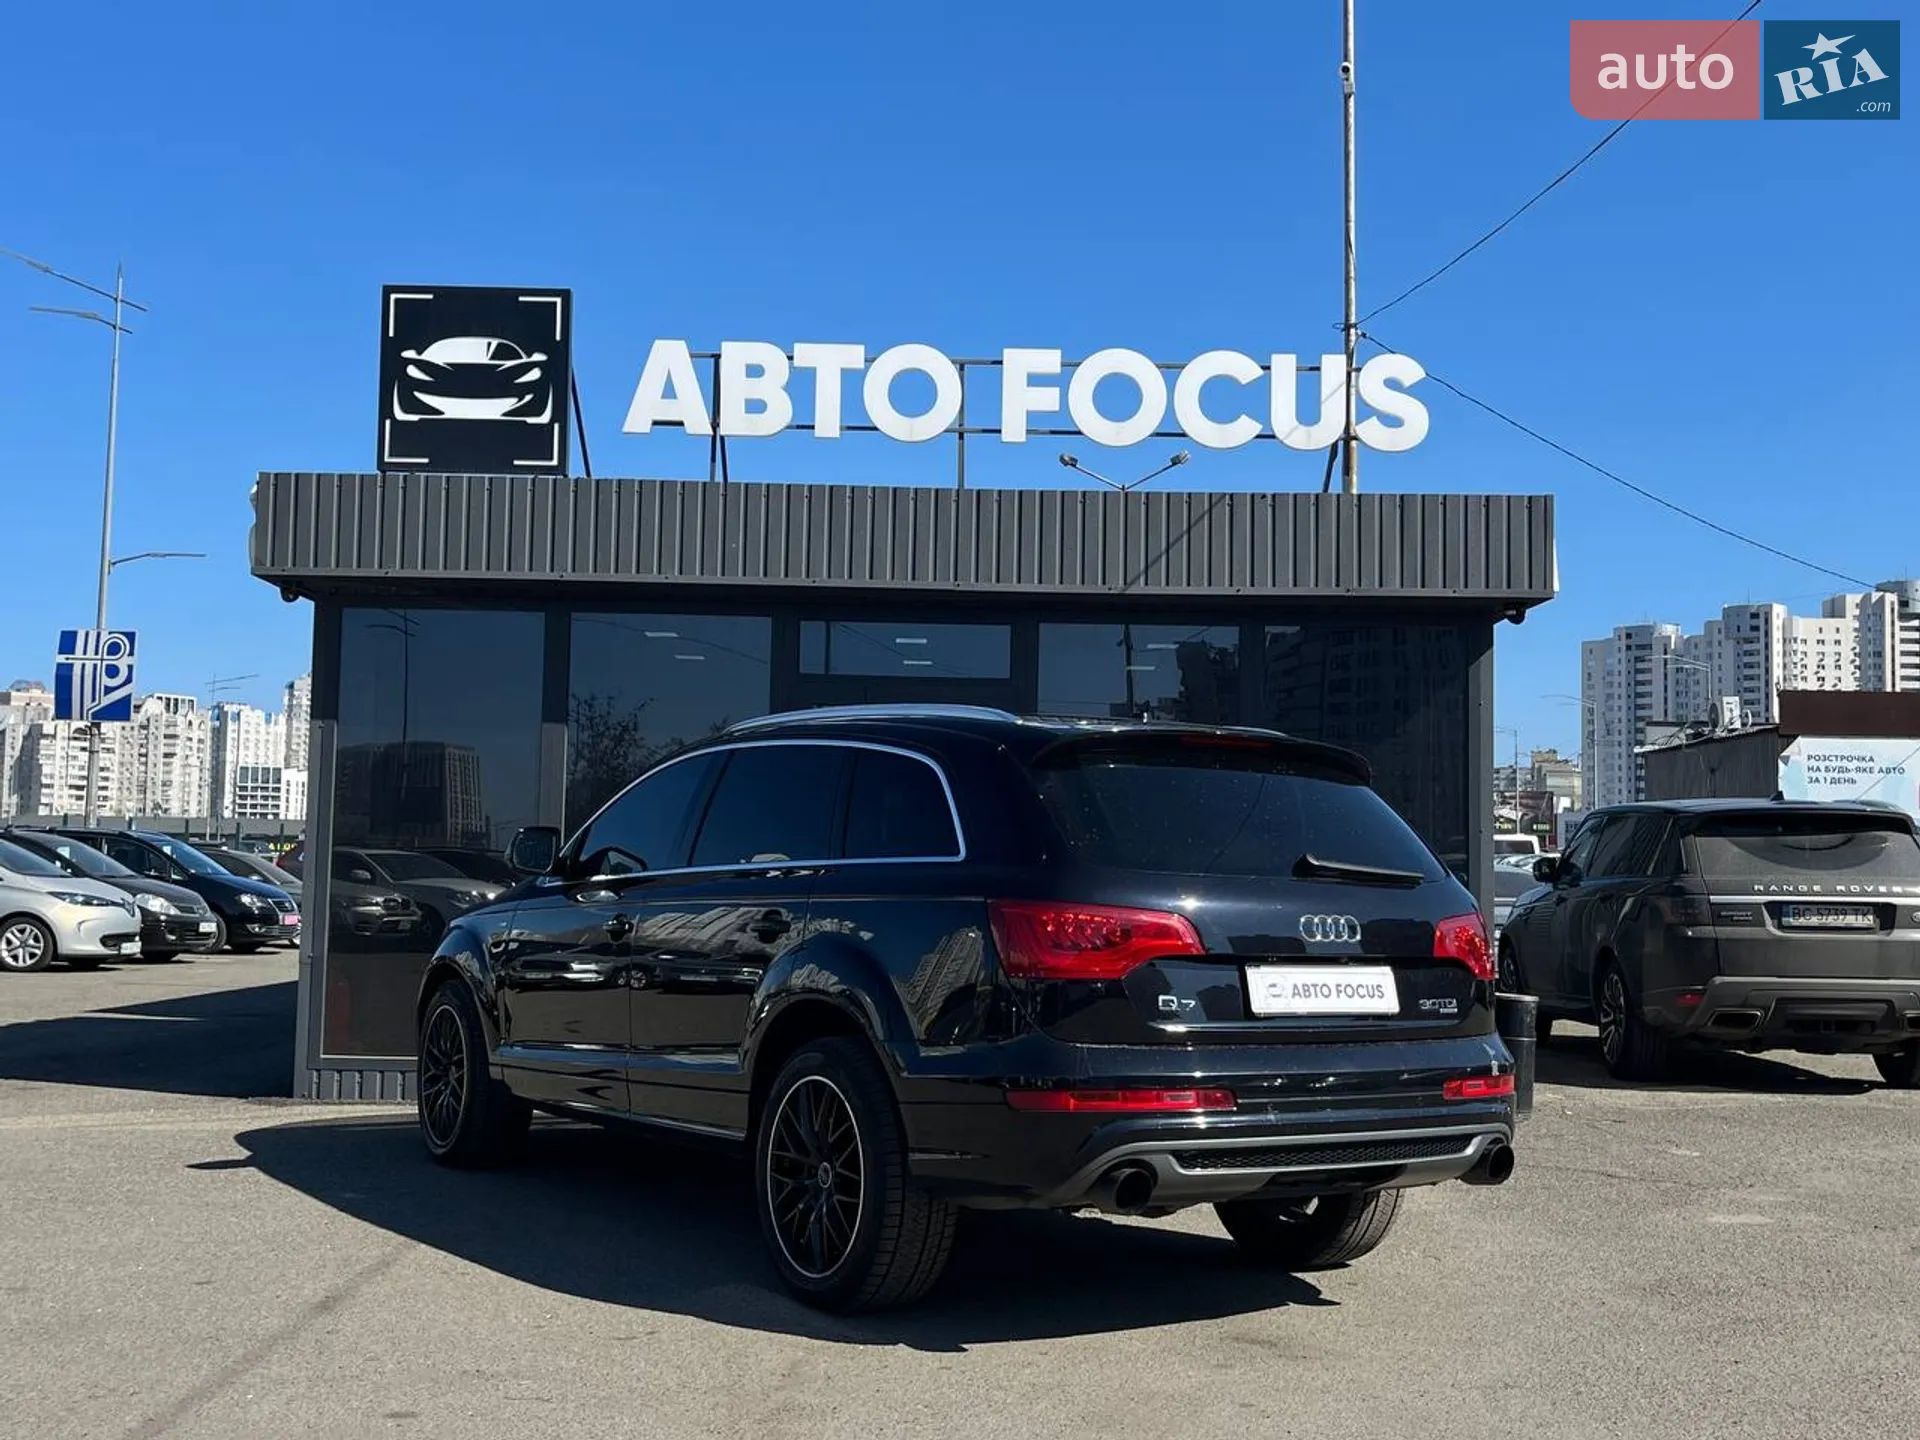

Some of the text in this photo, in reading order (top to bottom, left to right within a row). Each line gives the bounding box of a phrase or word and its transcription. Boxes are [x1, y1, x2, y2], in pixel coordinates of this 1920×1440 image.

[622, 339, 1431, 453] АВТО FOCUS
[1807, 754, 1875, 763] РОЗСТРОЧКА
[1807, 765, 1905, 775] НА БУДЬ-ЯКЕ АВТО
[1807, 776, 1857, 786] ЗА 1 ДЕНЬ
[1753, 884, 1904, 893] RANGE ROVER
[1792, 907, 1872, 923] BC 5739 TK
[1291, 984, 1385, 999] АВТО FOCUS
[1158, 994, 1196, 1011] Q7
